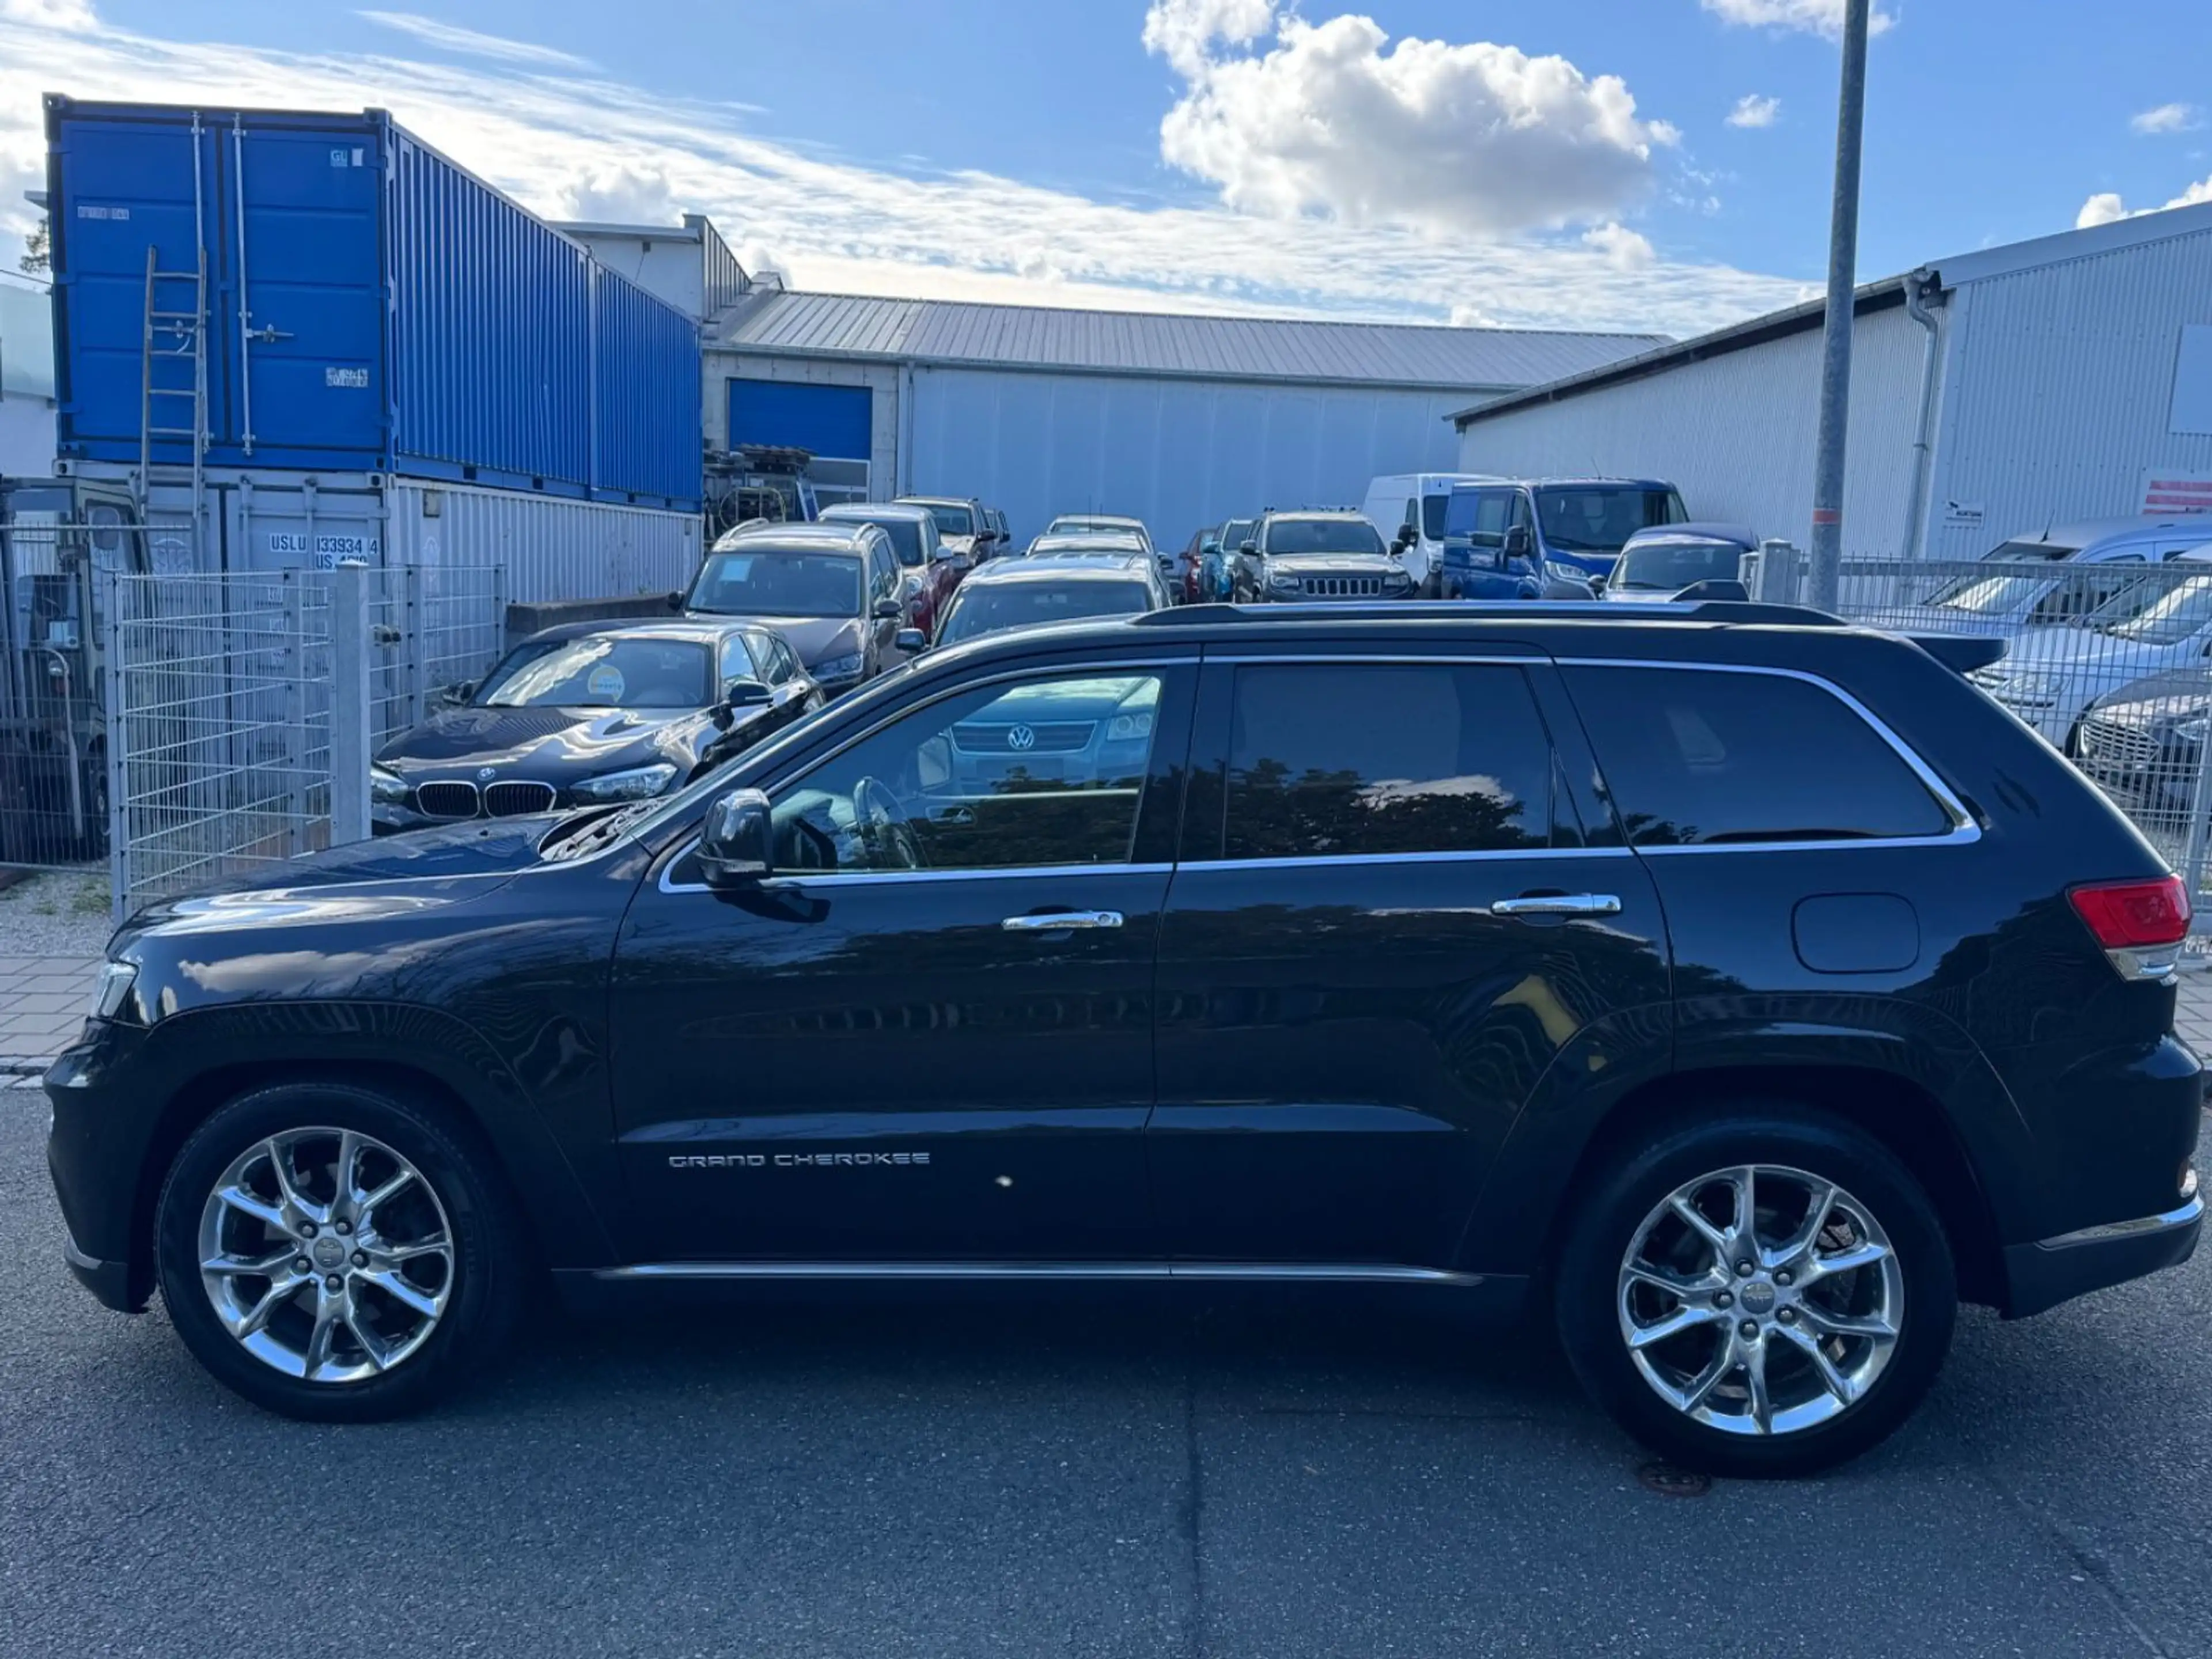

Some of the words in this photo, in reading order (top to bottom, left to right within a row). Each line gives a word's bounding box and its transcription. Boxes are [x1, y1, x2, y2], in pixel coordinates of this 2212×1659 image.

[271, 535, 306, 551] USLU
[317, 537, 362, 554] 133934
[370, 539, 377, 554] 4
[669, 1155, 766, 1168] GRAND
[774, 1152, 930, 1166] CHEROKEE
